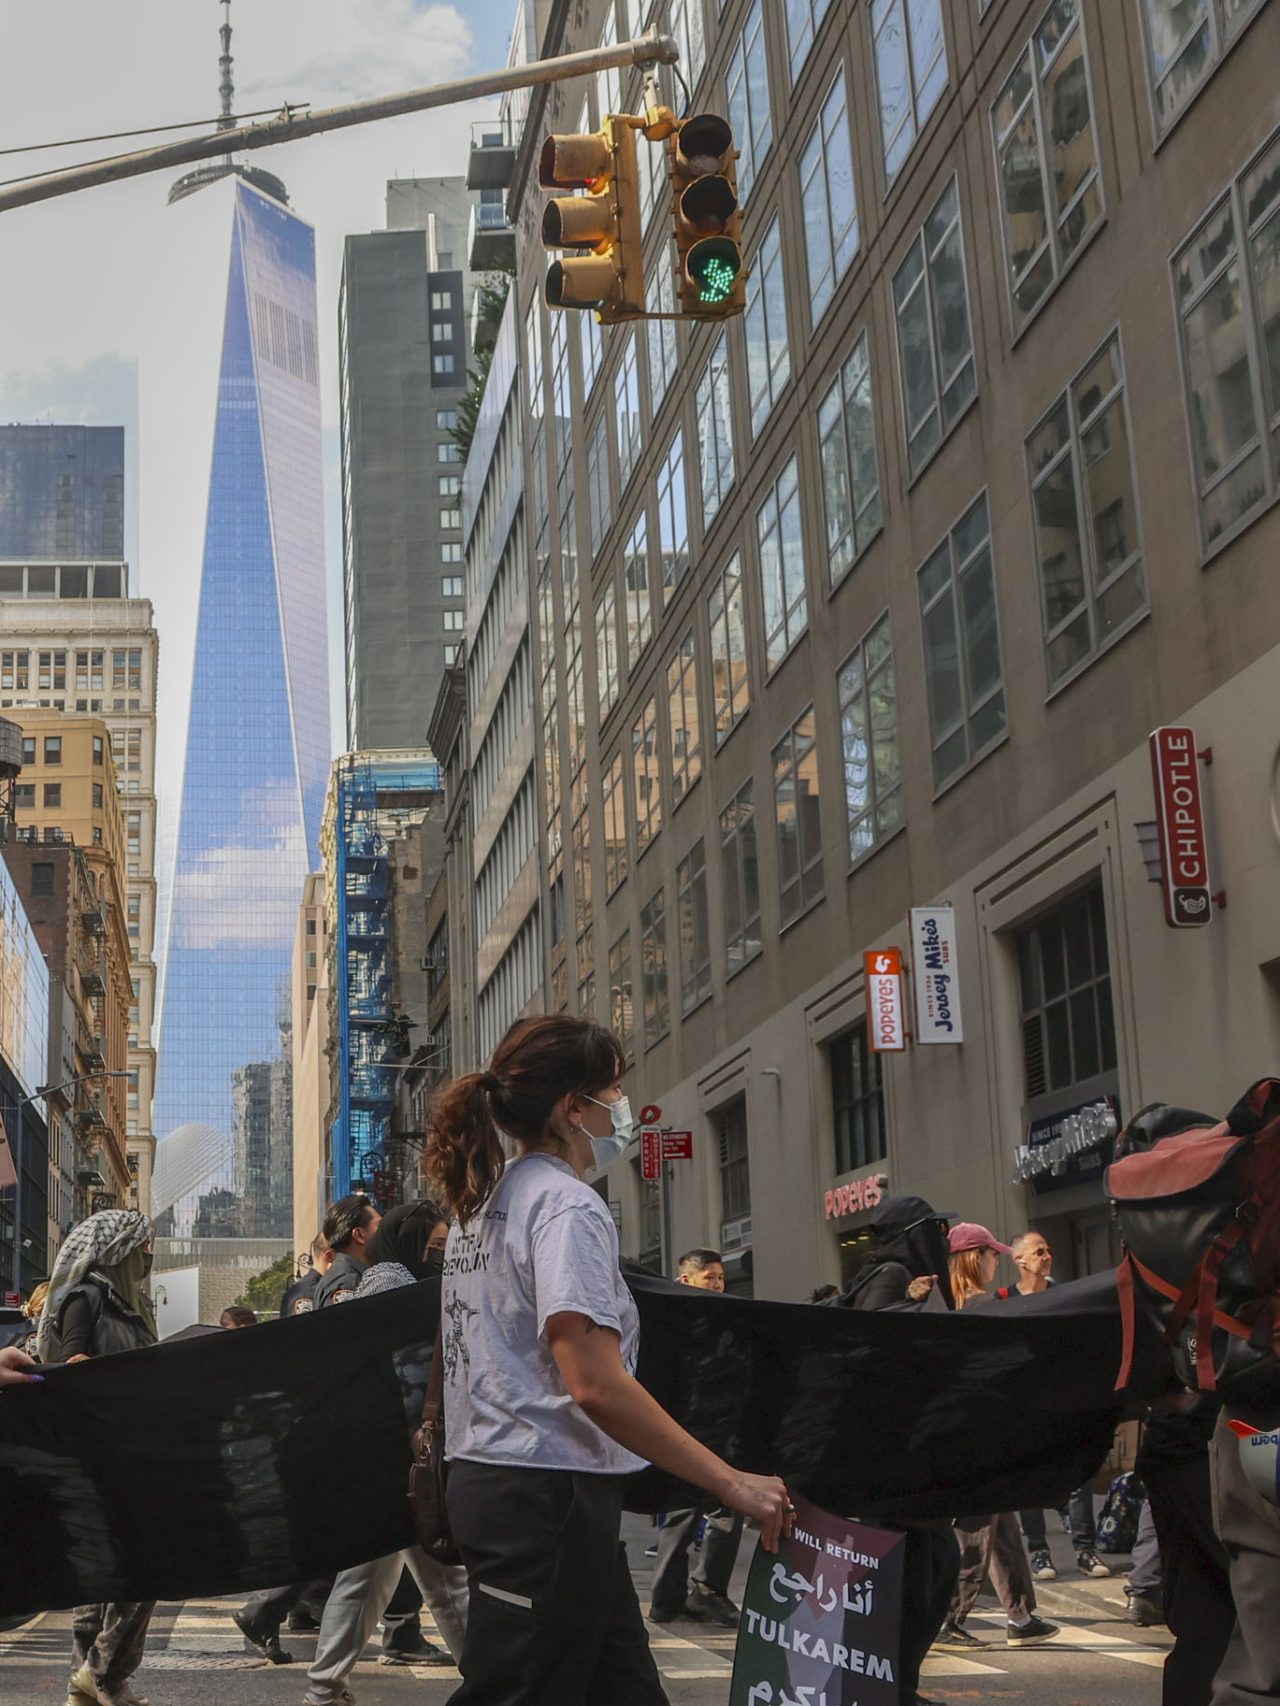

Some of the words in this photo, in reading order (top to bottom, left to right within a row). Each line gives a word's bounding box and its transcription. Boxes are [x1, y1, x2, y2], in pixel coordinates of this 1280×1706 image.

[1168, 736, 1200, 878] CHIPOTLE
[921, 918, 943, 970] Mike's
[941, 940, 950, 964] SUBS
[935, 974, 953, 1032] Jersey
[794, 1528, 822, 1551] WILL
[826, 1542, 880, 1570] RETURN
[770, 1563, 838, 1612] راجع
[842, 1580, 874, 1616] أنا
[746, 1608, 894, 1683] TULKAREM
